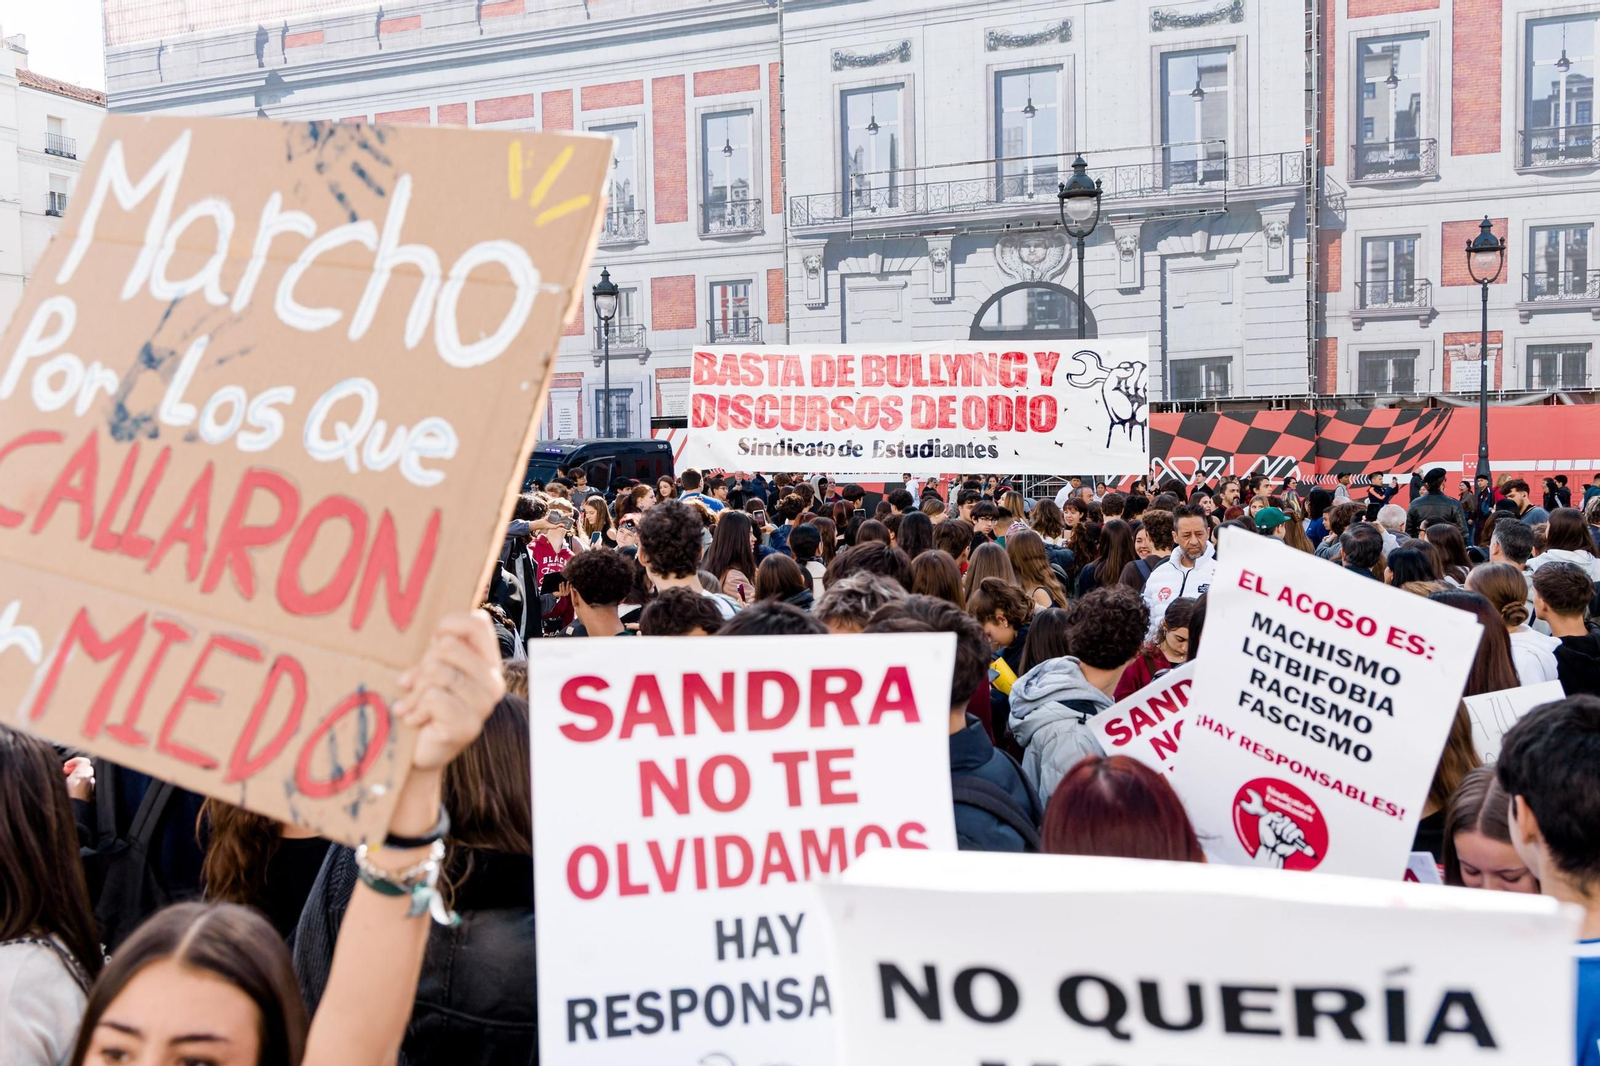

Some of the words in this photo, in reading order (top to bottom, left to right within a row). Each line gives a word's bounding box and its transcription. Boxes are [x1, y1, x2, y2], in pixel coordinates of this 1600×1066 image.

[55, 129, 541, 368] Marcho
[0, 295, 119, 416] Por
[159, 335, 296, 452] Los
[304, 377, 459, 487] Que
[692, 352, 806, 388] BASTA
[810, 353, 856, 388] DE
[861, 351, 1028, 389] BULLYING
[1034, 351, 1060, 388] Y
[691, 392, 904, 432] DISCURSOS
[910, 394, 957, 431] DE
[961, 394, 1058, 433] ODIO
[737, 437, 836, 458] Sindicato
[837, 440, 864, 458] de
[872, 438, 999, 459] Estudiantes
[0, 429, 442, 632] CALLARON
[1237, 569, 1270, 597] EL
[1276, 585, 1379, 638] ACOSO
[1385, 625, 1436, 662] ES:
[1251, 612, 1401, 686] MACHISMO
[29, 605, 391, 799] MIEDO
[557, 665, 922, 743] SANDRA
[1242, 637, 1395, 717] LGTBIFOBIA
[1250, 668, 1373, 734] RACISMO
[1238, 690, 1372, 763] FASCISMO
[638, 754, 752, 818] NO
[771, 748, 860, 808] TE
[1196, 714, 1236, 742] ¡HAY
[1239, 734, 1407, 821] RESPONSABLES!
[715, 913, 805, 961] HAY
[566, 975, 832, 1043] RESPONSA
[878, 961, 1020, 1024] NO
[1057, 966, 1498, 1049] QUERÍA
